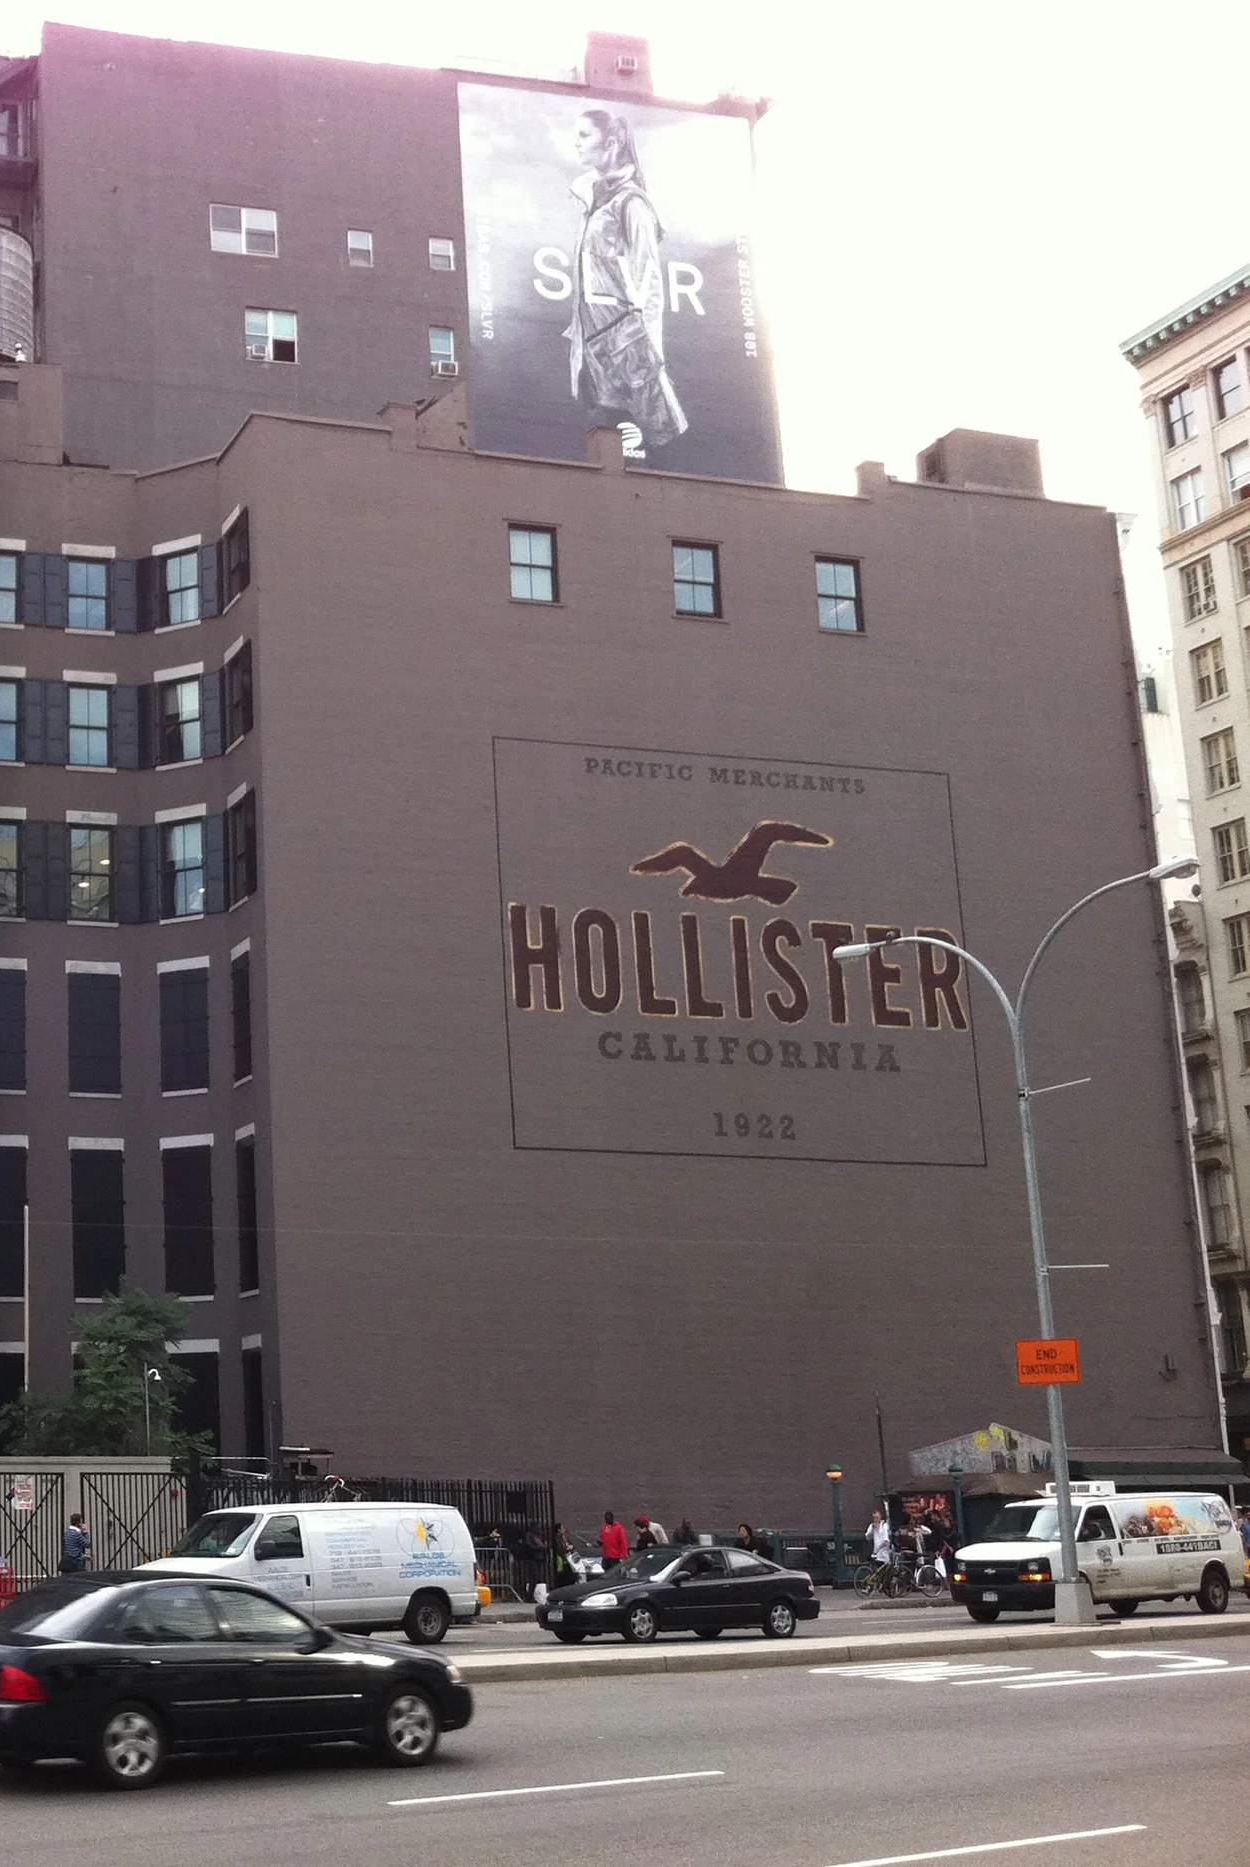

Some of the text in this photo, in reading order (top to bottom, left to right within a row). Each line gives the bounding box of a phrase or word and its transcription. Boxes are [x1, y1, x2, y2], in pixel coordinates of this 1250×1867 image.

[533, 246, 706, 316] SLVR
[738, 259, 756, 328] WOOSTER
[744, 332, 758, 358] 108
[584, 757, 866, 795] PACIFIC MERCHANTS
[508, 903, 969, 1033] HOLLISTER
[597, 1030, 901, 1074] CALIFORNIA
[713, 1111, 798, 1141] 1922
[1036, 1348, 1058, 1360] END
[1021, 1364, 1075, 1376] CONSTRUCTION
[399, 1569, 462, 1578] CORPORATION
[400, 1560, 458, 1570] MECHANICAL
